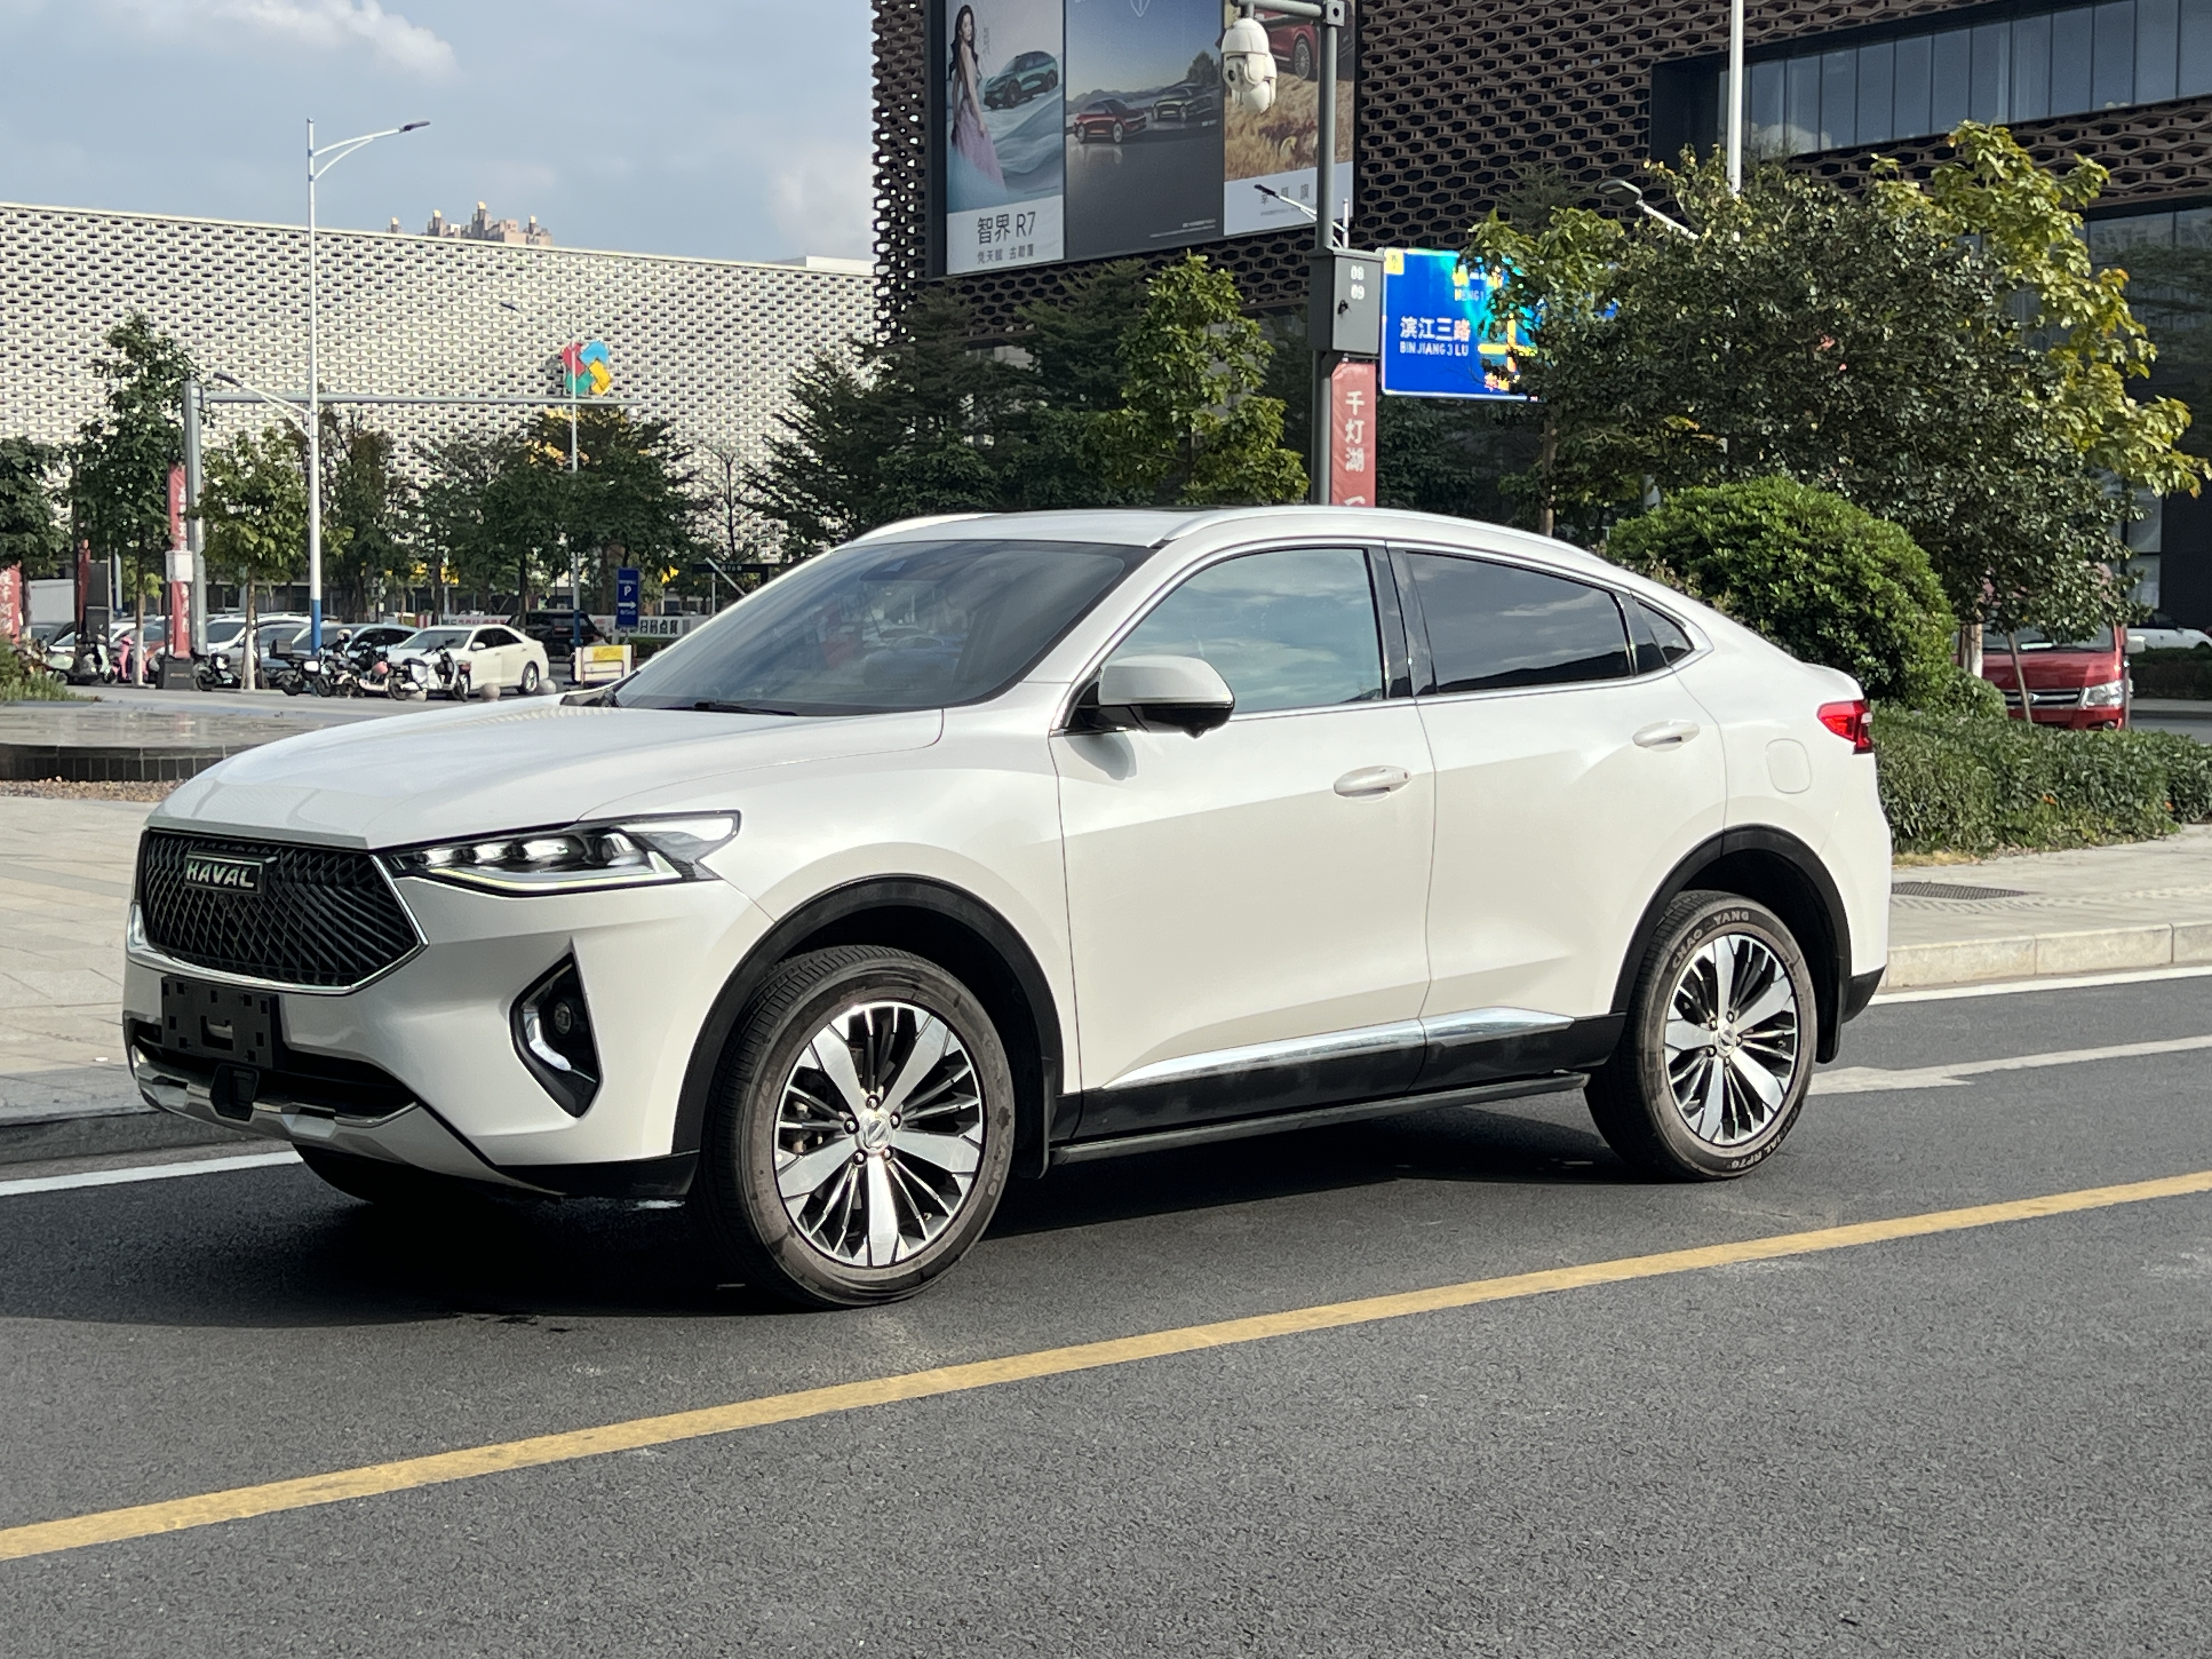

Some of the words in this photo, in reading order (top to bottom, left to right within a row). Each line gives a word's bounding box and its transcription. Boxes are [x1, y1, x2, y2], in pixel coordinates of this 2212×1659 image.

[978, 213, 1011, 245] 智界
[1016, 211, 1036, 237] R7
[1351, 266, 1364, 280] 08
[1351, 284, 1365, 300] 09
[1400, 316, 1470, 341] 滨江三路
[1454, 343, 1469, 357] LU
[1345, 390, 1365, 472] 千灯湖
[186, 860, 255, 888] HAVAL
[1672, 929, 1703, 969] CHAO
[1713, 910, 1750, 926] YANG
